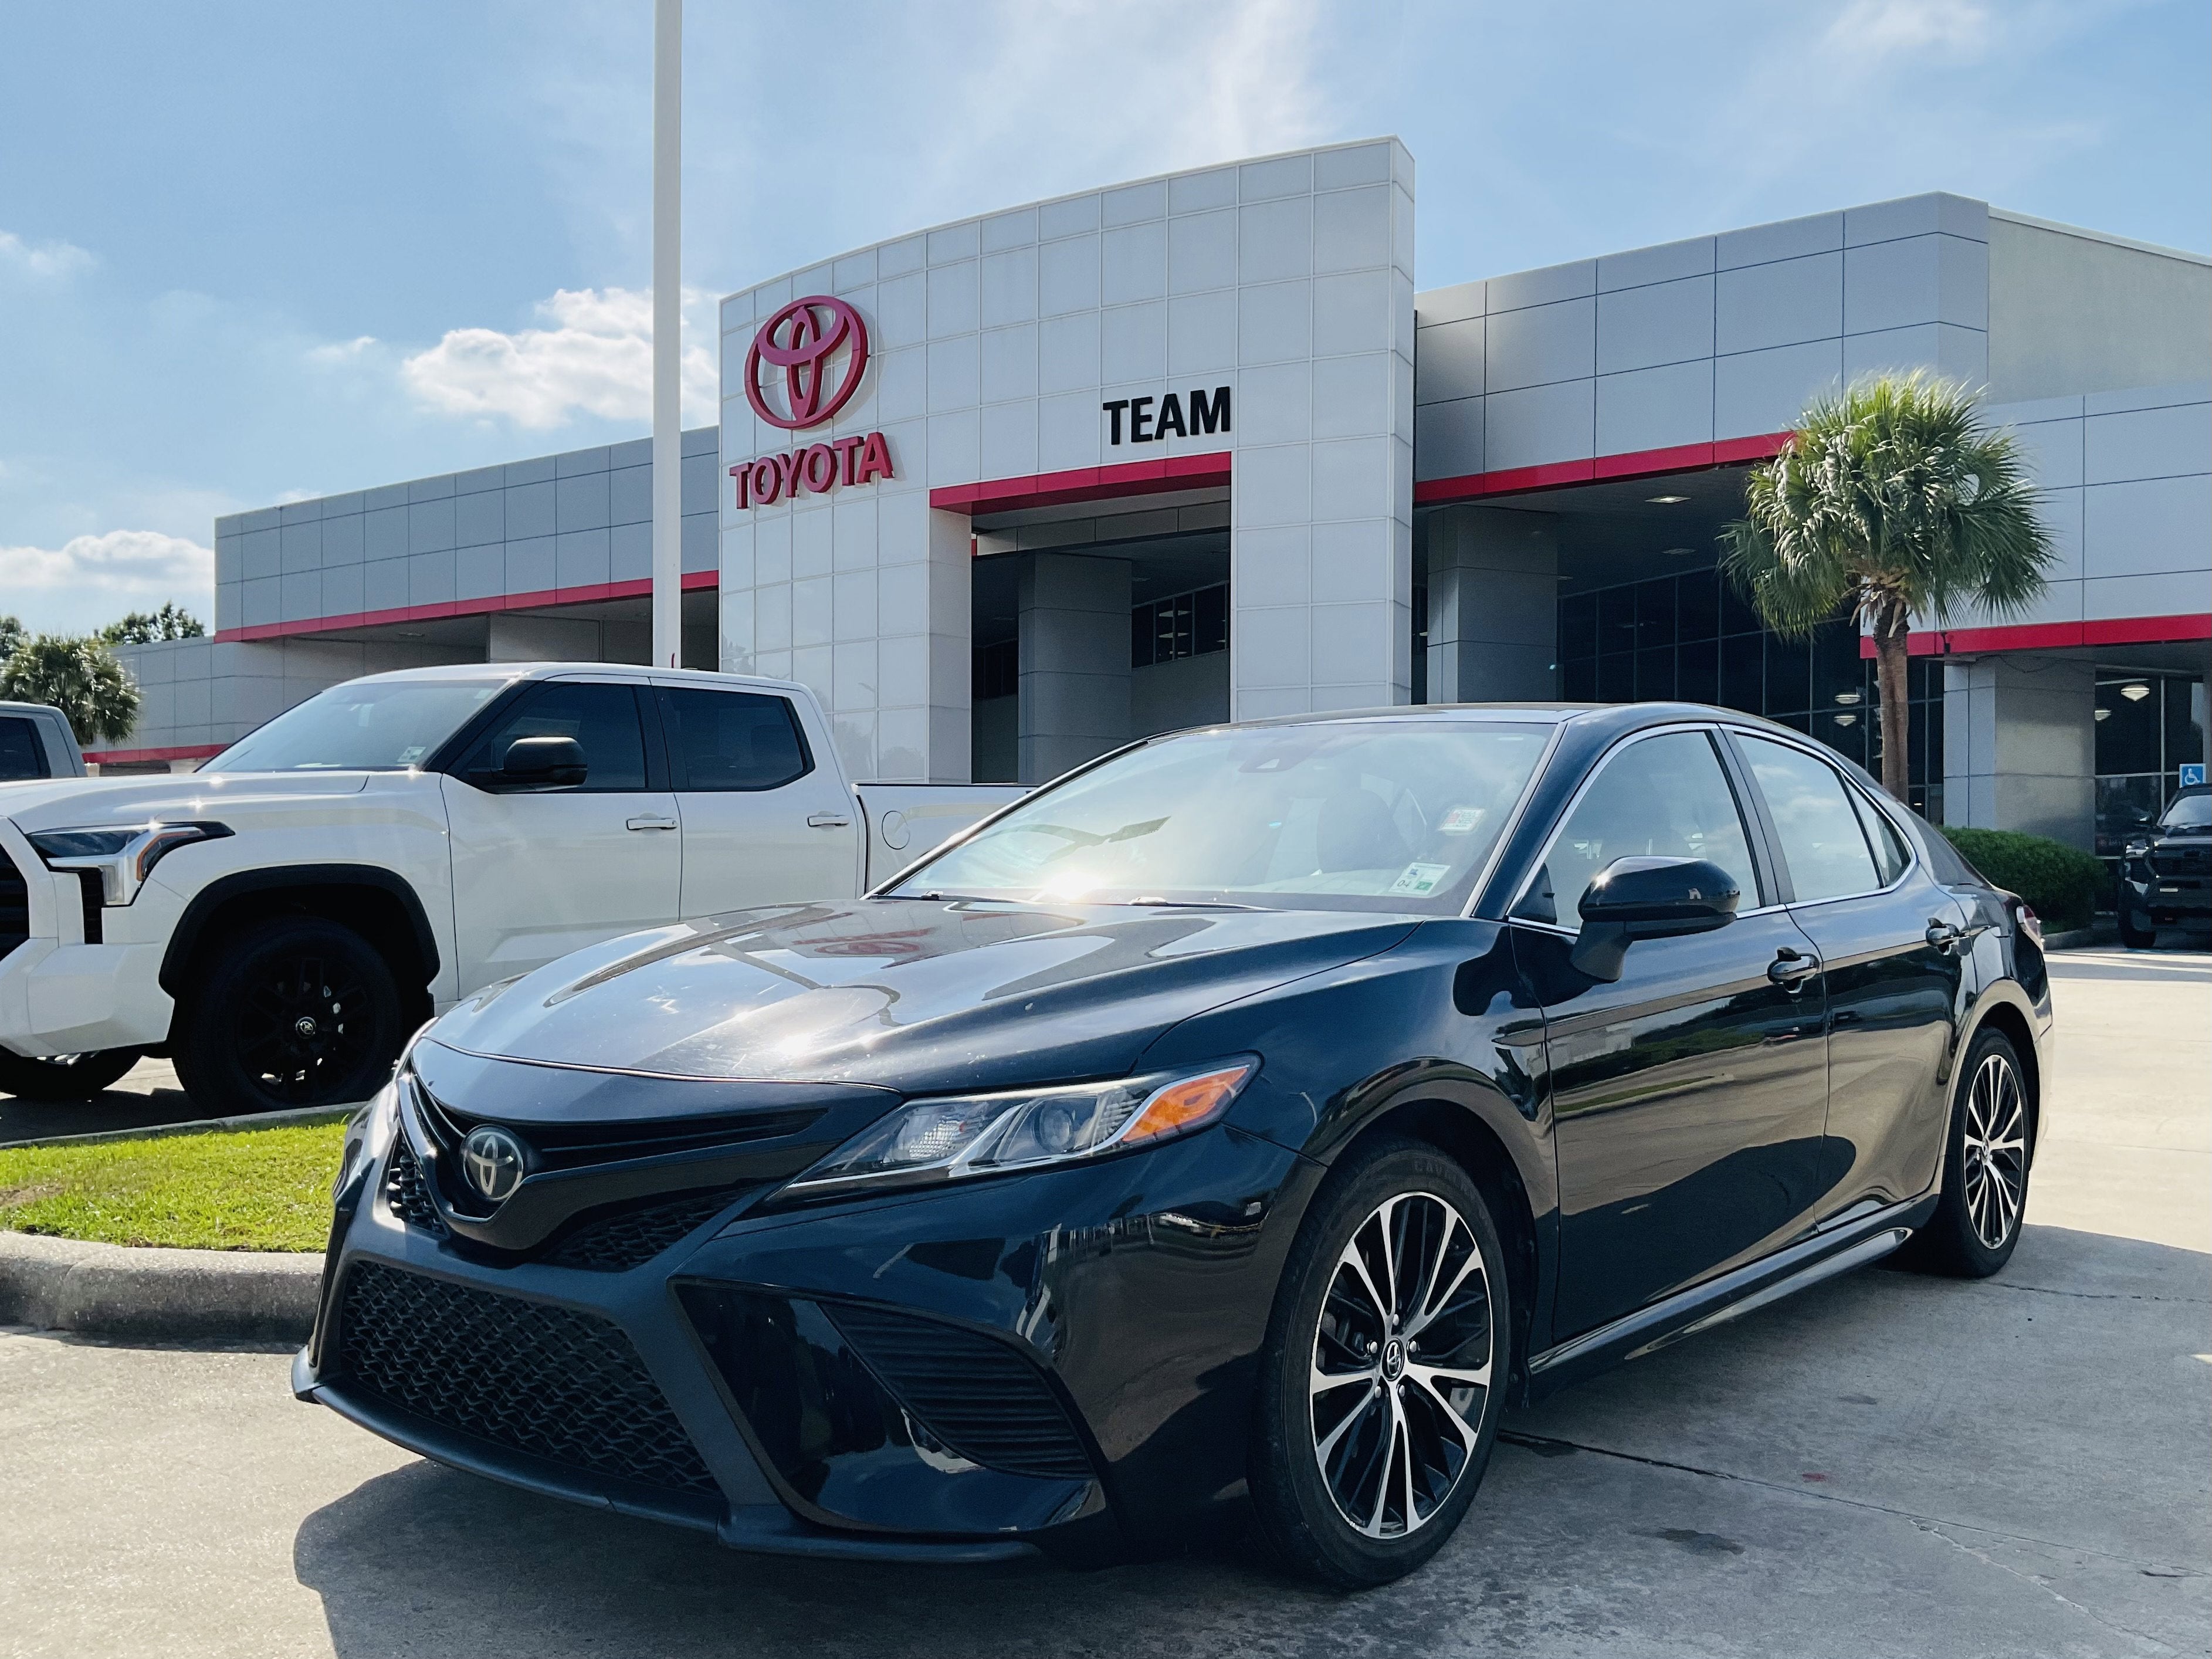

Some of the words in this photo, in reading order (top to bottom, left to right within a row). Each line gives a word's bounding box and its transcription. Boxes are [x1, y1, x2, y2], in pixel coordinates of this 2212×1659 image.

[1103, 387, 1230, 445] TEAM
[729, 432, 895, 509] TOYOTA
[1397, 879, 1412, 888] 04
